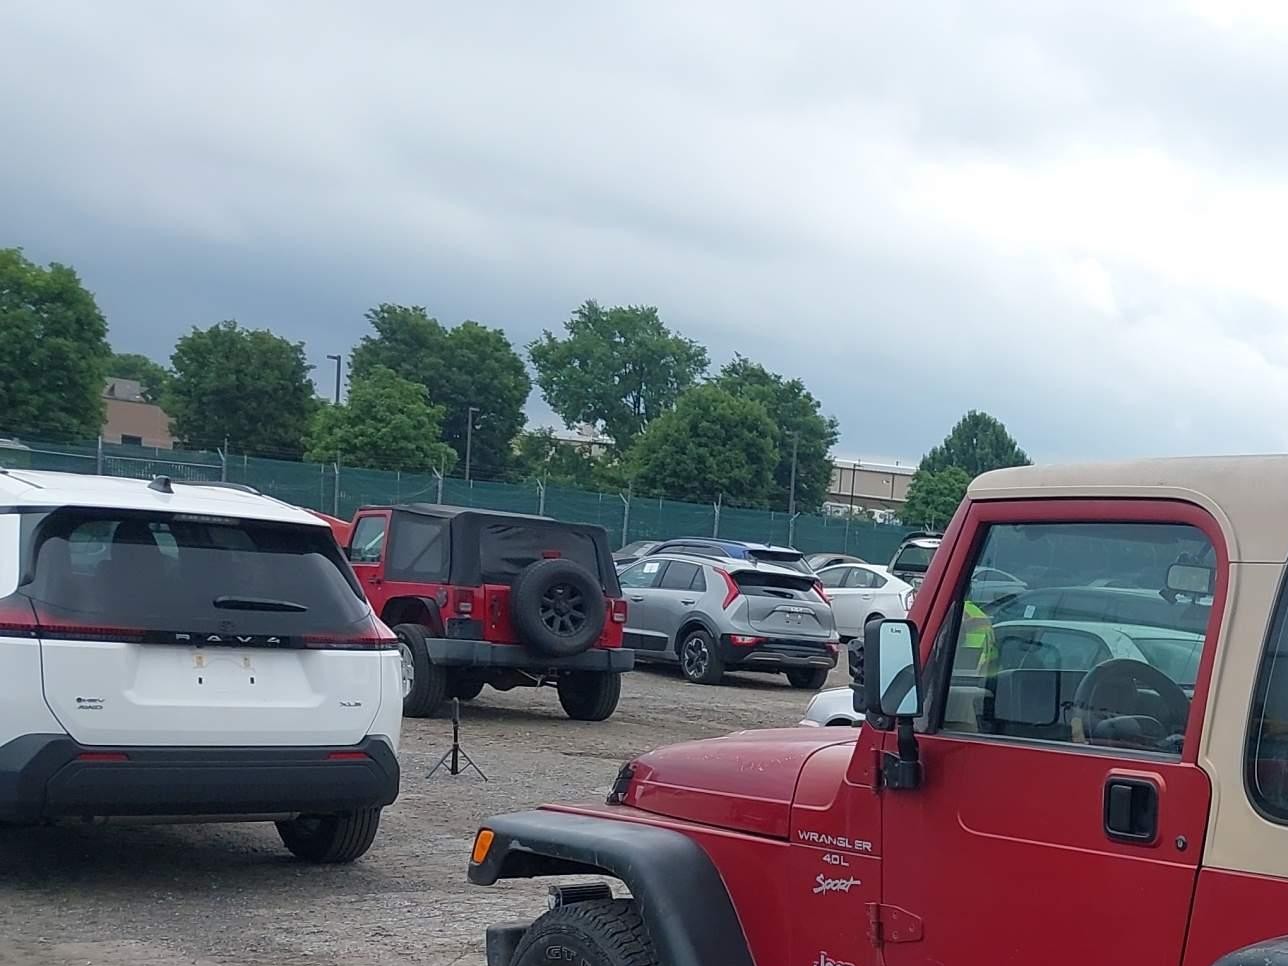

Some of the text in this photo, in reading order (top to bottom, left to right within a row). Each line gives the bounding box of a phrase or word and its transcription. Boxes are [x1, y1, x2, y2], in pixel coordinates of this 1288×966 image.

[175, 633, 281, 645] RAV4
[797, 829, 872, 852] WRANGLER
[812, 873, 861, 895] Sport
